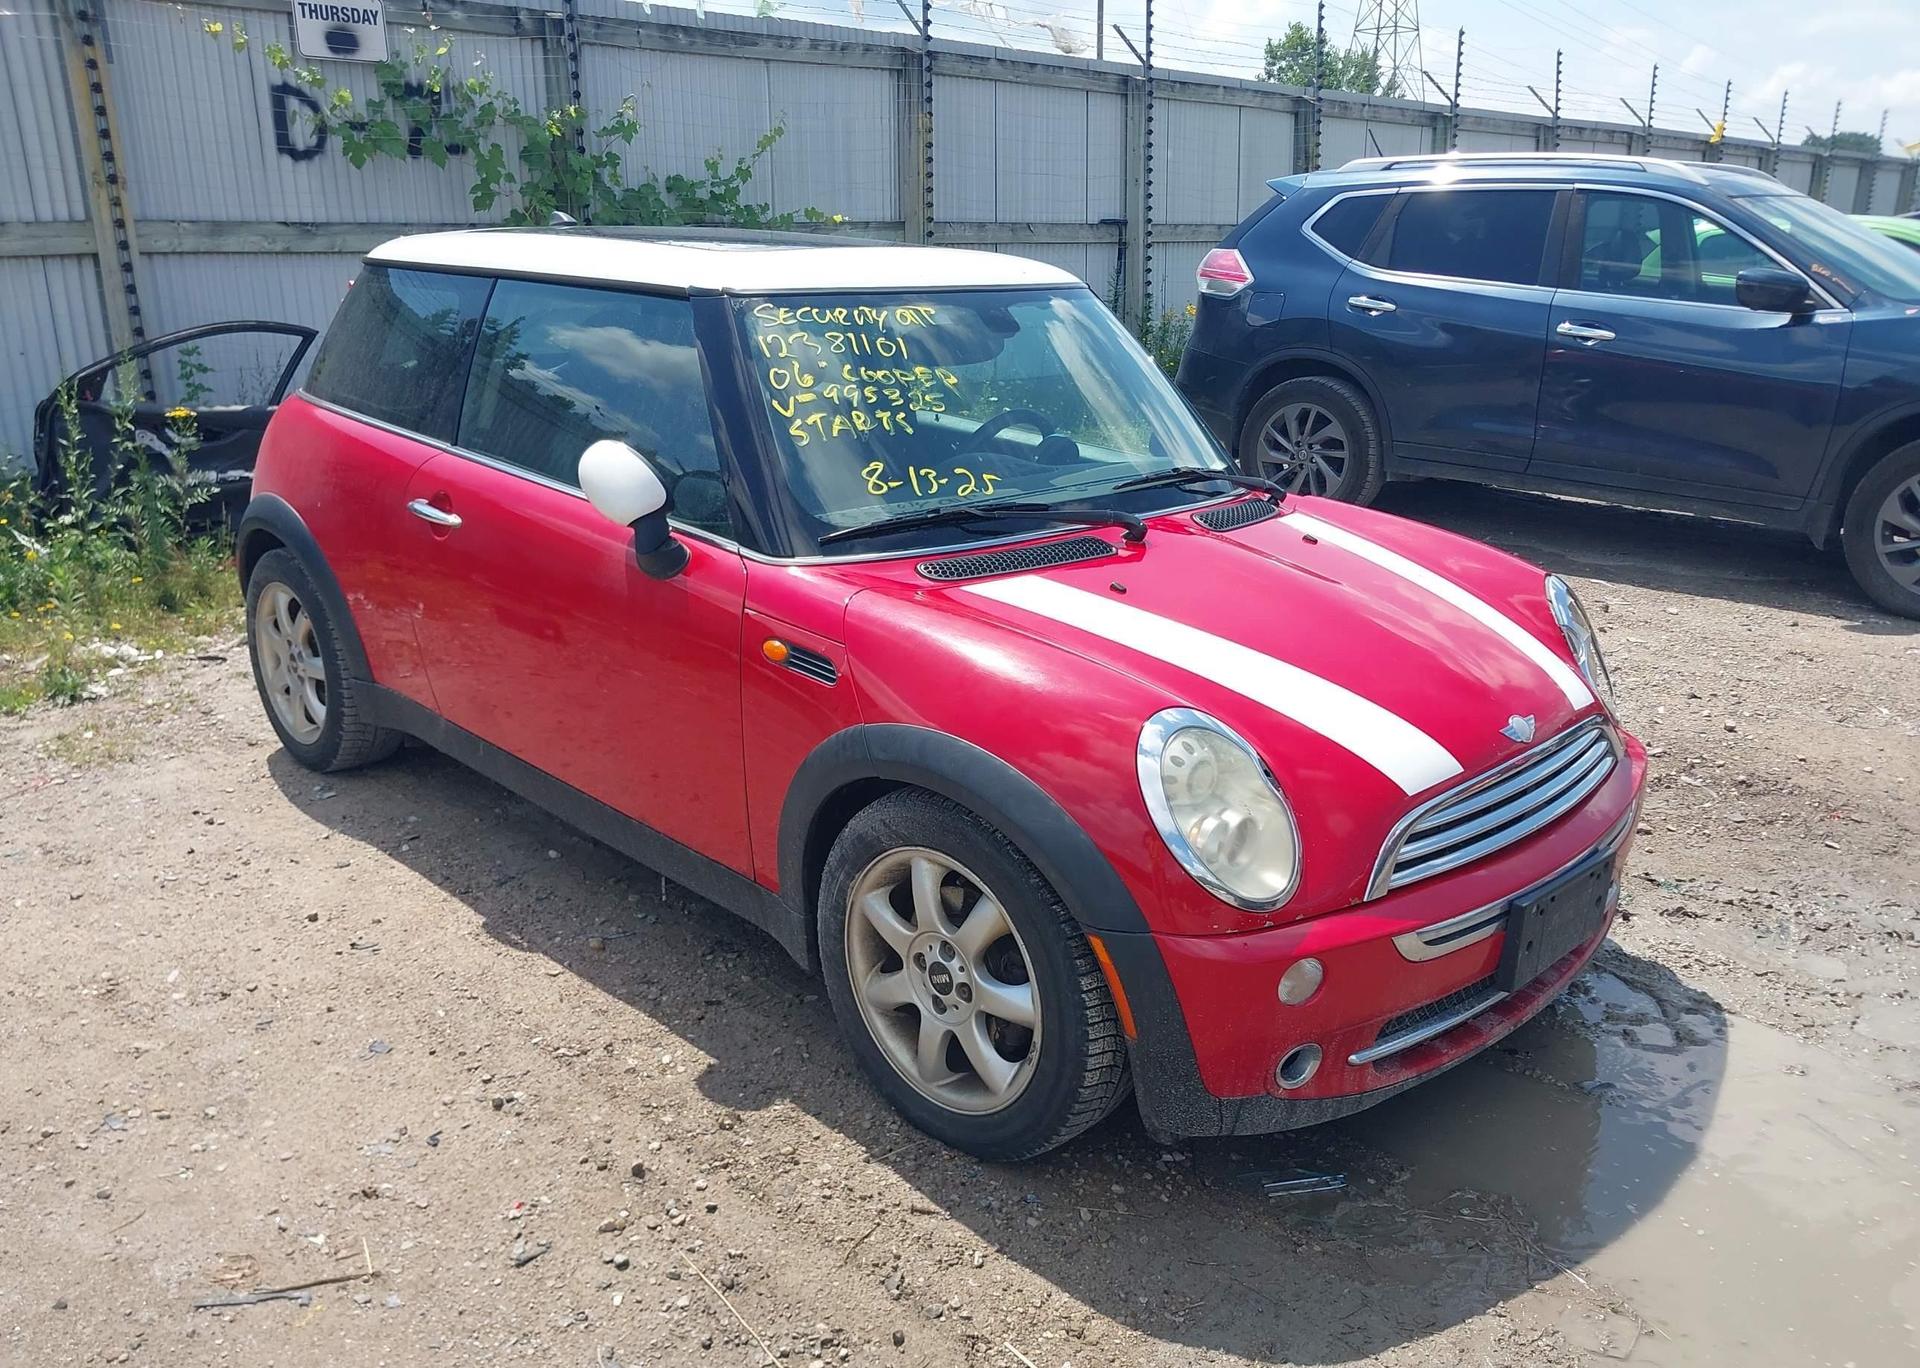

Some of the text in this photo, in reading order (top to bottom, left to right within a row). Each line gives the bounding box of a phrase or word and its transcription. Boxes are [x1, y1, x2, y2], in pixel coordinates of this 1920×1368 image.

[298, 2, 379, 26] THURSDAY
[753, 303, 888, 333] SECURITY
[789, 409, 914, 447] STARTS
[861, 461, 1003, 496] 8-13-25
